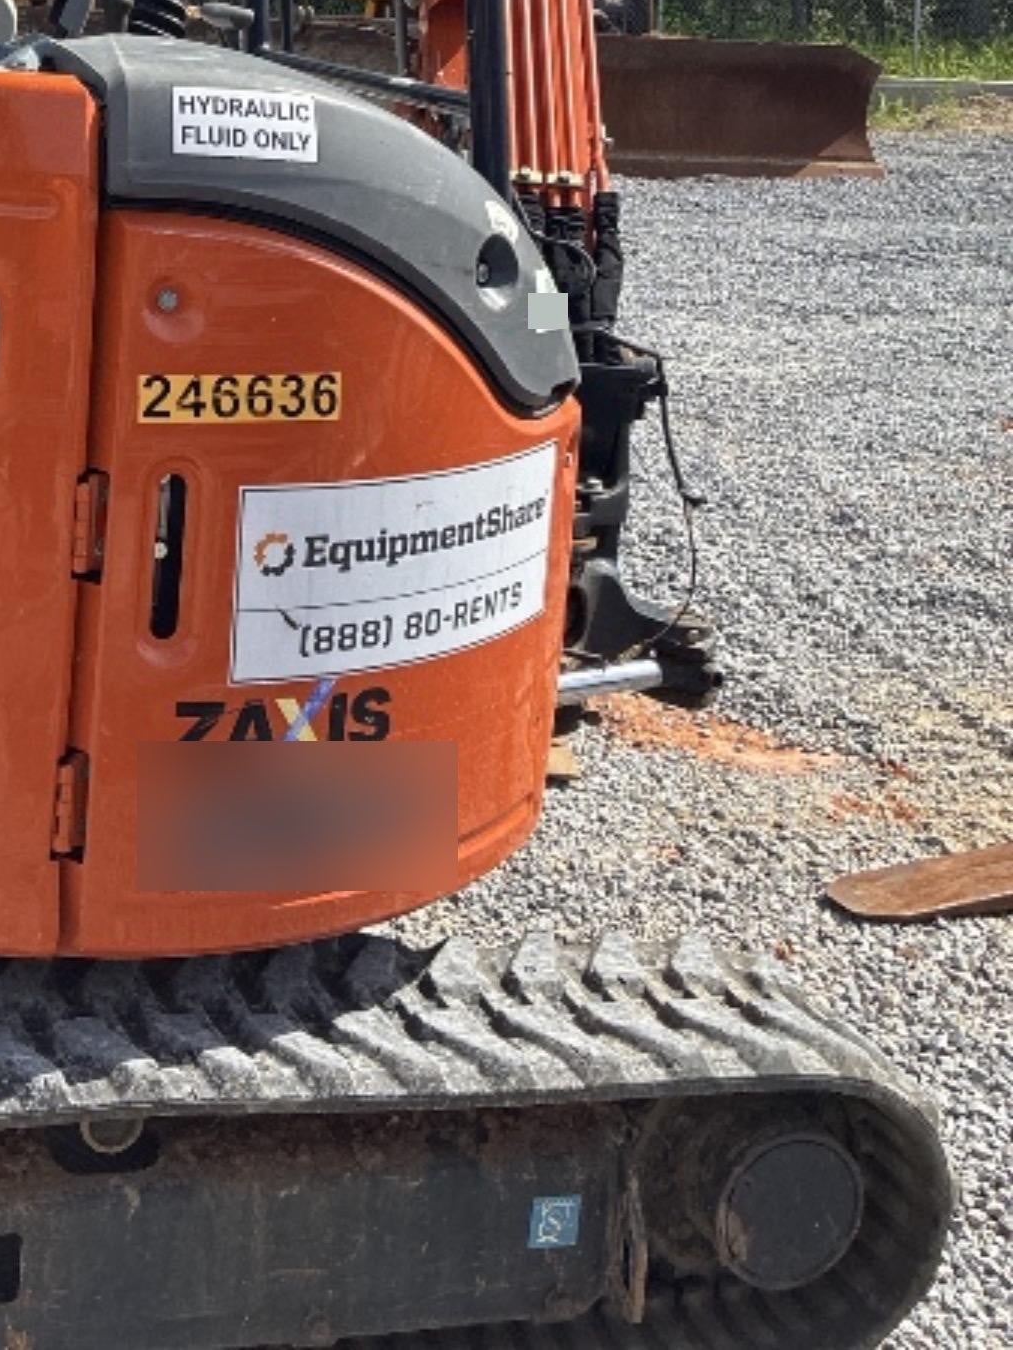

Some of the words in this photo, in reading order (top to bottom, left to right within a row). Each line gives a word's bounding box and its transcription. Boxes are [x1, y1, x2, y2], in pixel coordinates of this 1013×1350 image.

[178, 96, 310, 122] HYDRAULIC
[181, 127, 246, 148] FLUID
[253, 131, 311, 152] ONLY
[142, 374, 338, 418] 246636
[302, 497, 547, 573] EquipmentShare
[299, 617, 393, 658] (888)
[403, 581, 524, 640] 80-RENTS
[175, 678, 392, 742] ZAXIS
